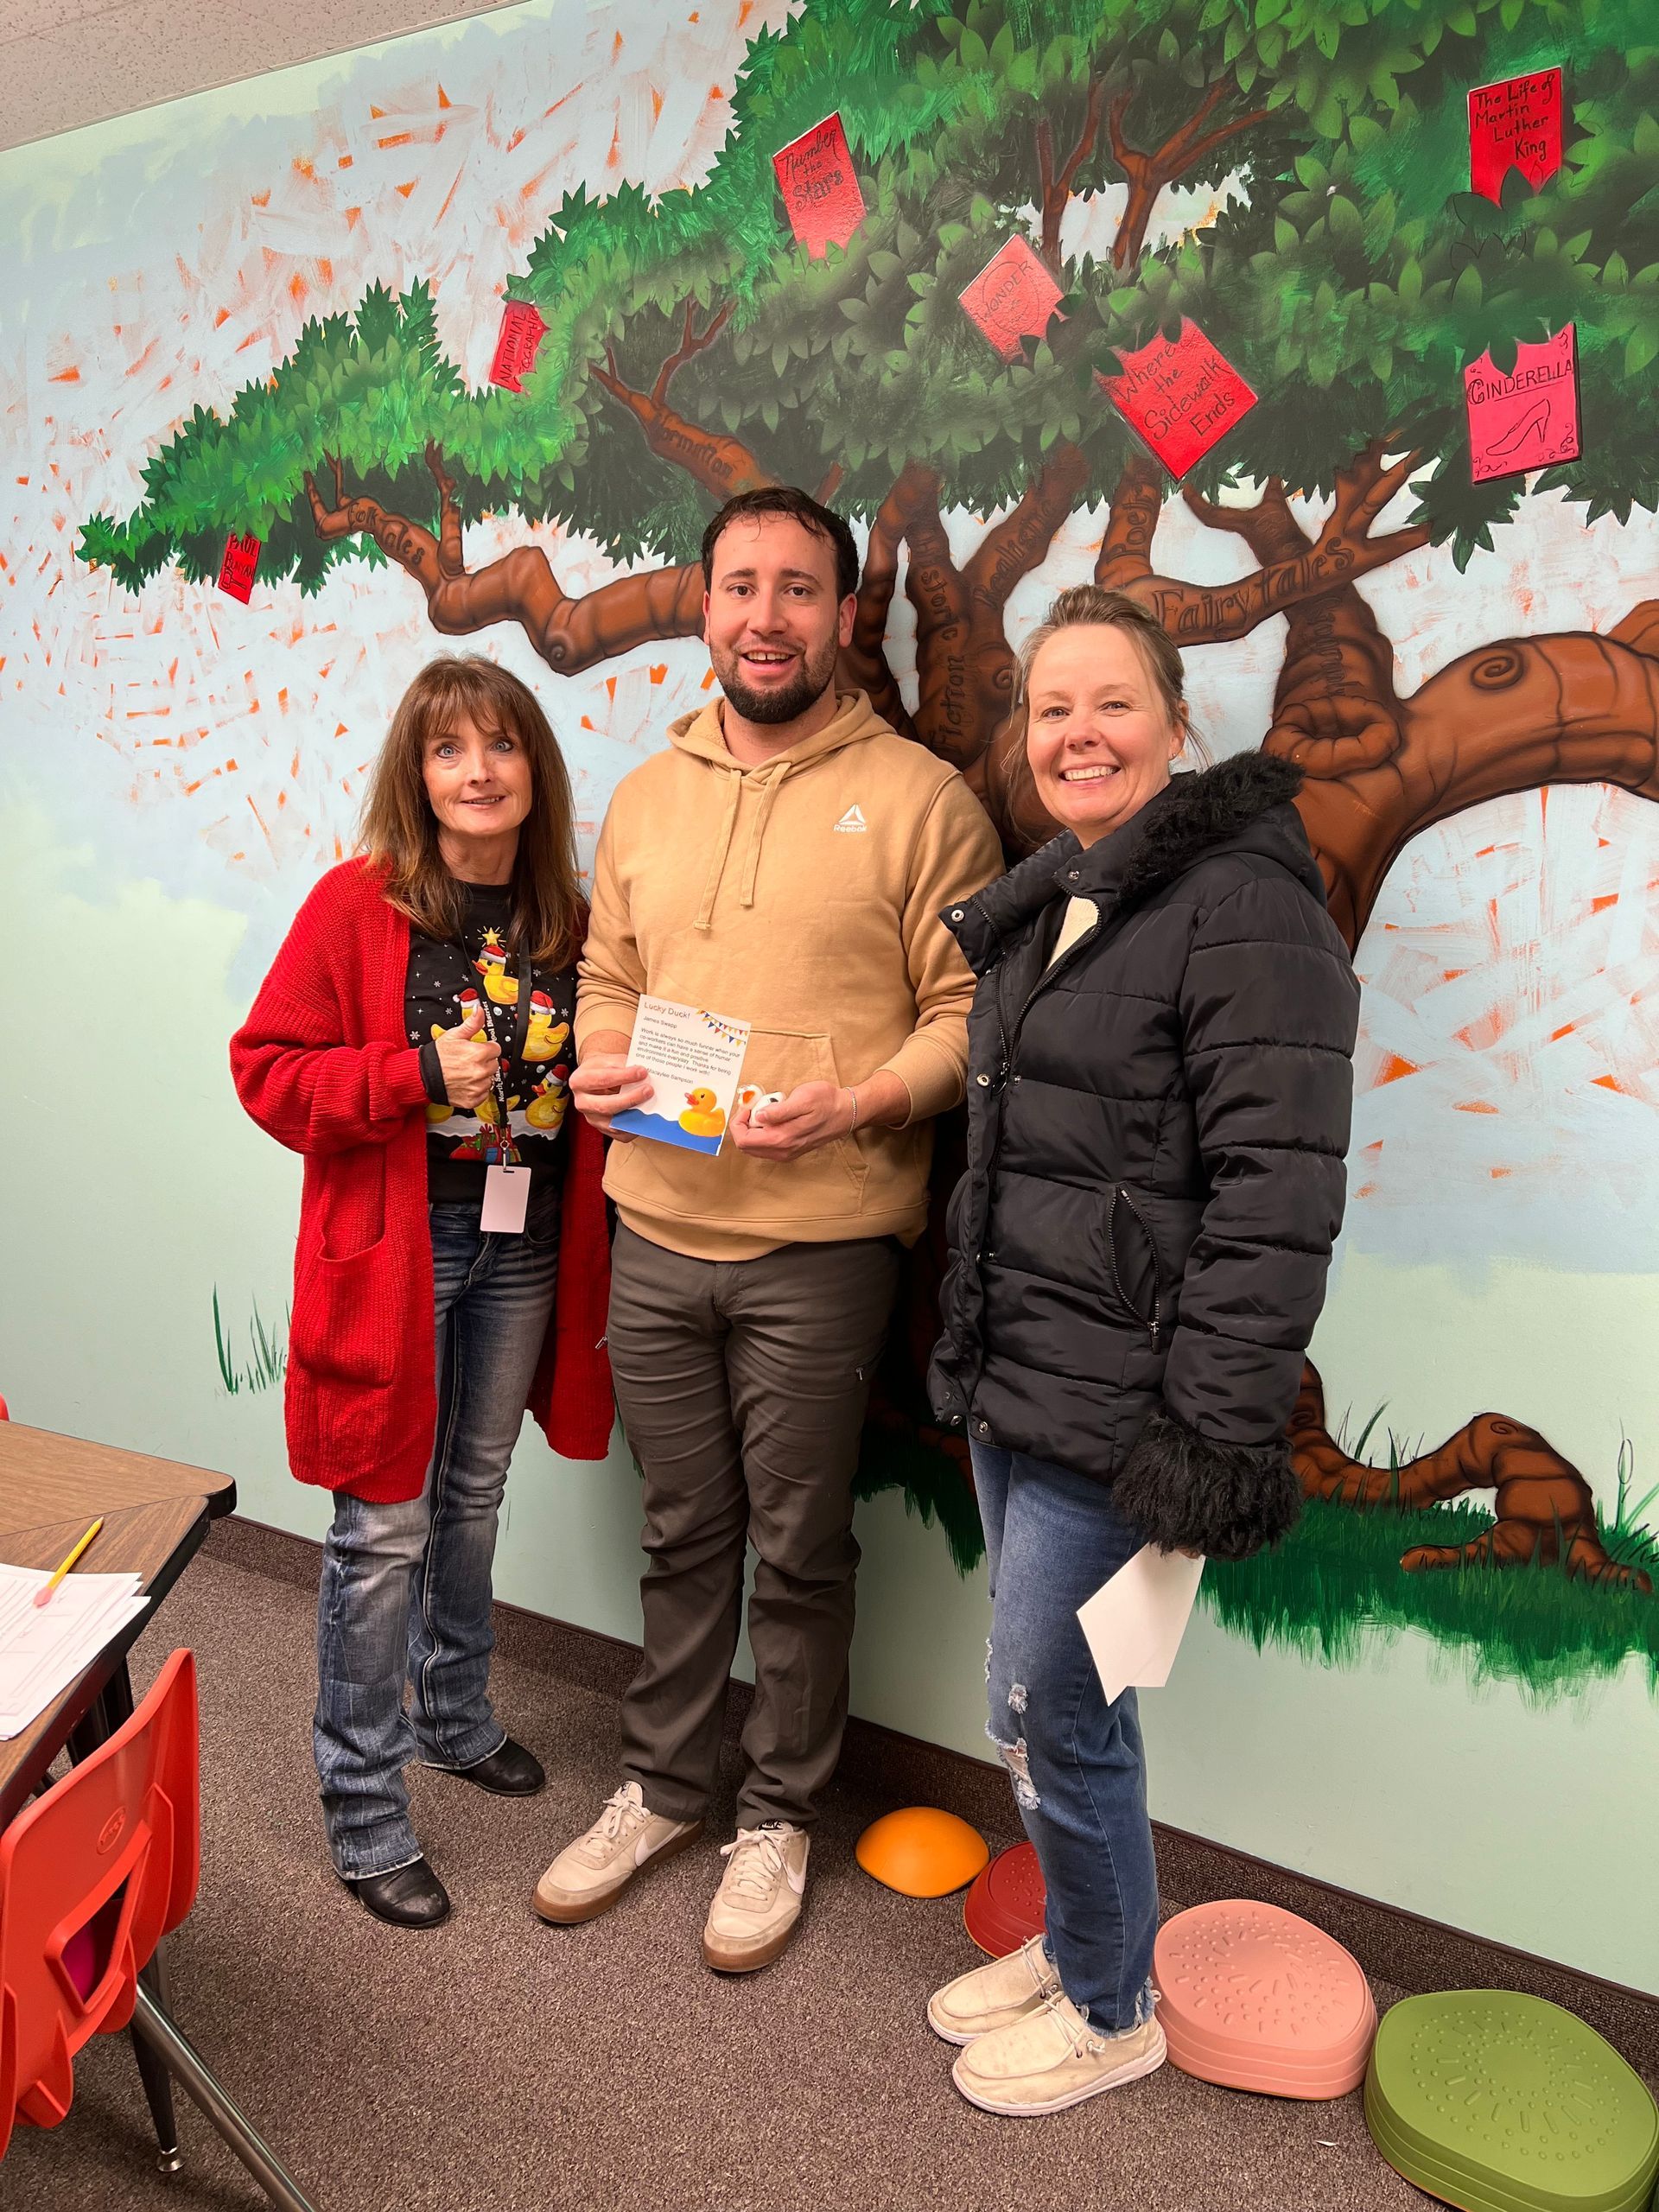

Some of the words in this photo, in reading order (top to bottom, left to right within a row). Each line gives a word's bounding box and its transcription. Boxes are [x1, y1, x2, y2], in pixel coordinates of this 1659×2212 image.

[1474, 92, 1501, 109] The
[1508, 79, 1536, 102] Life
[1541, 73, 1555, 105] of
[1476, 103, 1529, 129] Martin
[1494, 116, 1548, 143] Luther
[780, 128, 841, 182] Number
[1515, 137, 1547, 162] King
[803, 160, 823, 178] the
[973, 260, 1034, 323] WONDER
[1113, 343, 1175, 404] Where
[1156, 369, 1185, 393] the
[1468, 359, 1573, 405] CINDERELLA
[1143, 355, 1237, 441] Sidewalk
[1189, 392, 1236, 436] Ends
[1153, 580, 1251, 638] Fairy
[1254, 536, 1355, 601] tales
[833, 823, 868, 833] Reebok
[483, 1001, 493, 1027] District
[645, 1001, 666, 1014] Lucky
[667, 1007, 690, 1020] Duck!
[691, 1060, 709, 1069] Thanks
[496, 1081, 505, 1102] North
